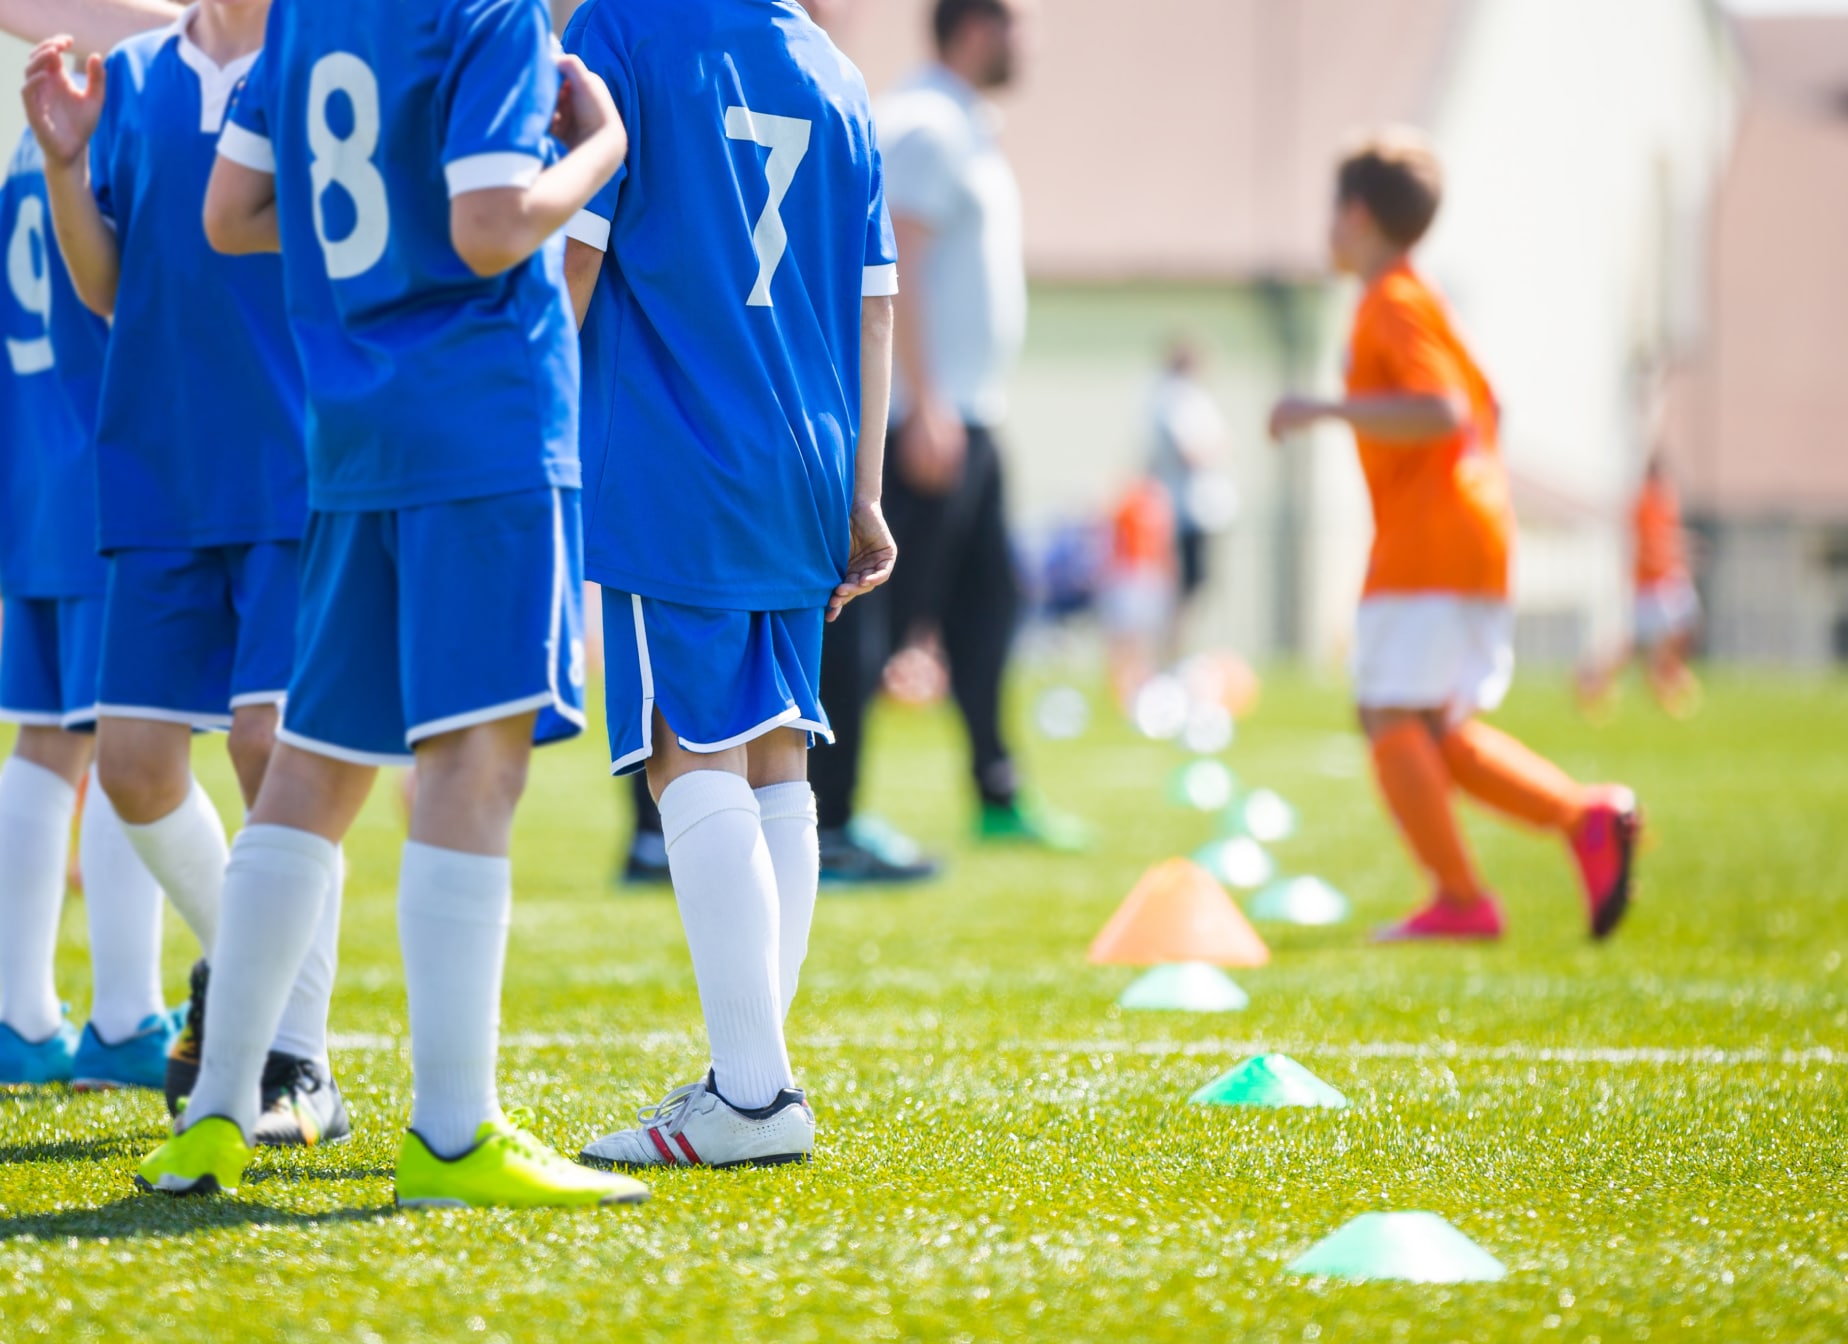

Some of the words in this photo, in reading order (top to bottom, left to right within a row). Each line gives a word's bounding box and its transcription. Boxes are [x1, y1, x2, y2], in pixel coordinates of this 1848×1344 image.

[308, 51, 390, 280] 8
[724, 105, 812, 307] 7
[6, 194, 55, 375] 9
